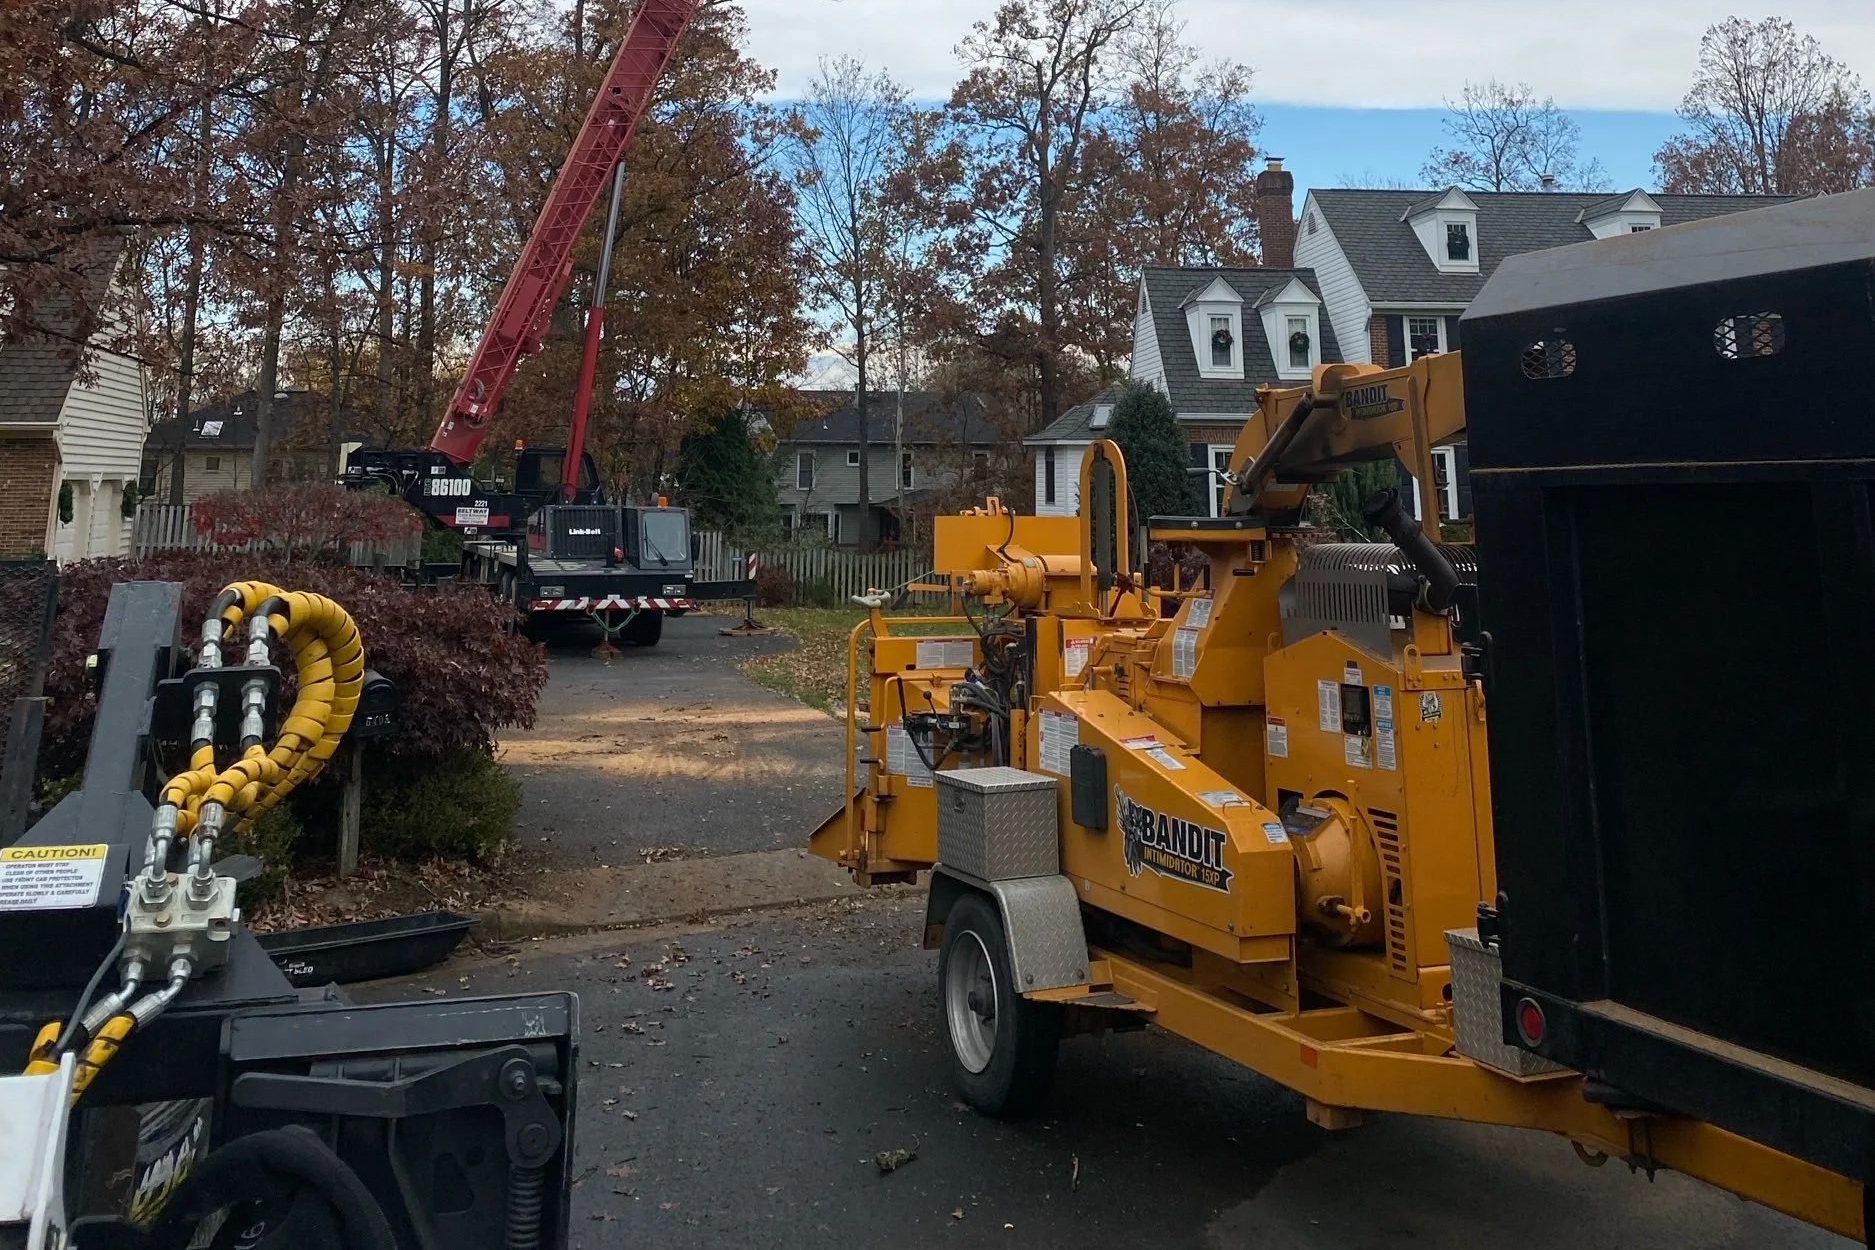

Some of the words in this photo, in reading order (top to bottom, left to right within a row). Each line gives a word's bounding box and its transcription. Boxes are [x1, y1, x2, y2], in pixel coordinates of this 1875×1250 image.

[1345, 384, 1388, 408] BANDIT
[431, 478, 472, 496] 86100
[1141, 805, 1226, 871] BANDIT
[11, 848, 97, 859] CAUTION!
[1144, 847, 1198, 879] INTIMIDATOR
[1201, 869, 1220, 886] 15XP
